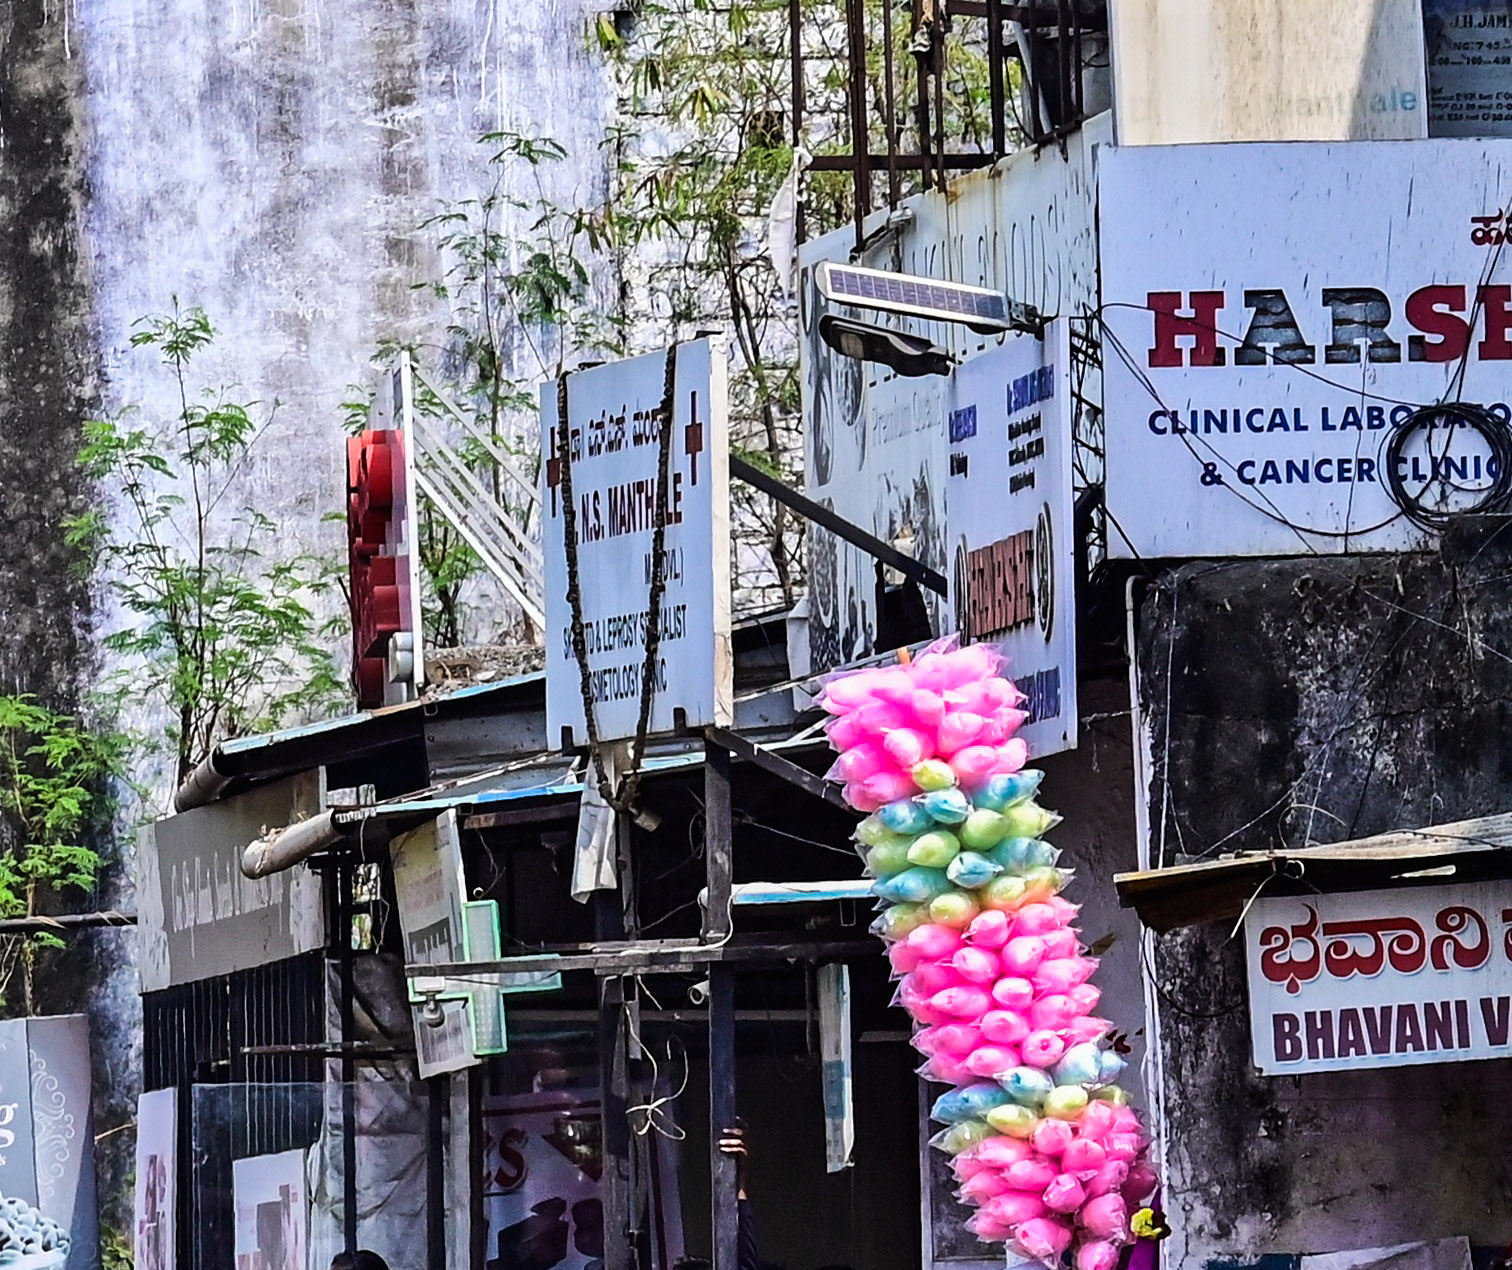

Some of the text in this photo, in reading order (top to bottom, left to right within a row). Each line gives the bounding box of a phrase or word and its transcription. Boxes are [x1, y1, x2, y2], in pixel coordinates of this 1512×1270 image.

[1149, 407, 1310, 435] CLINICAL
[1200, 463, 1223, 486] &
[1237, 458, 1376, 484] CANCER
[1258, 902, 1491, 995] ಭವಾನಿ
[1272, 998, 1471, 1062] BHAVANI
